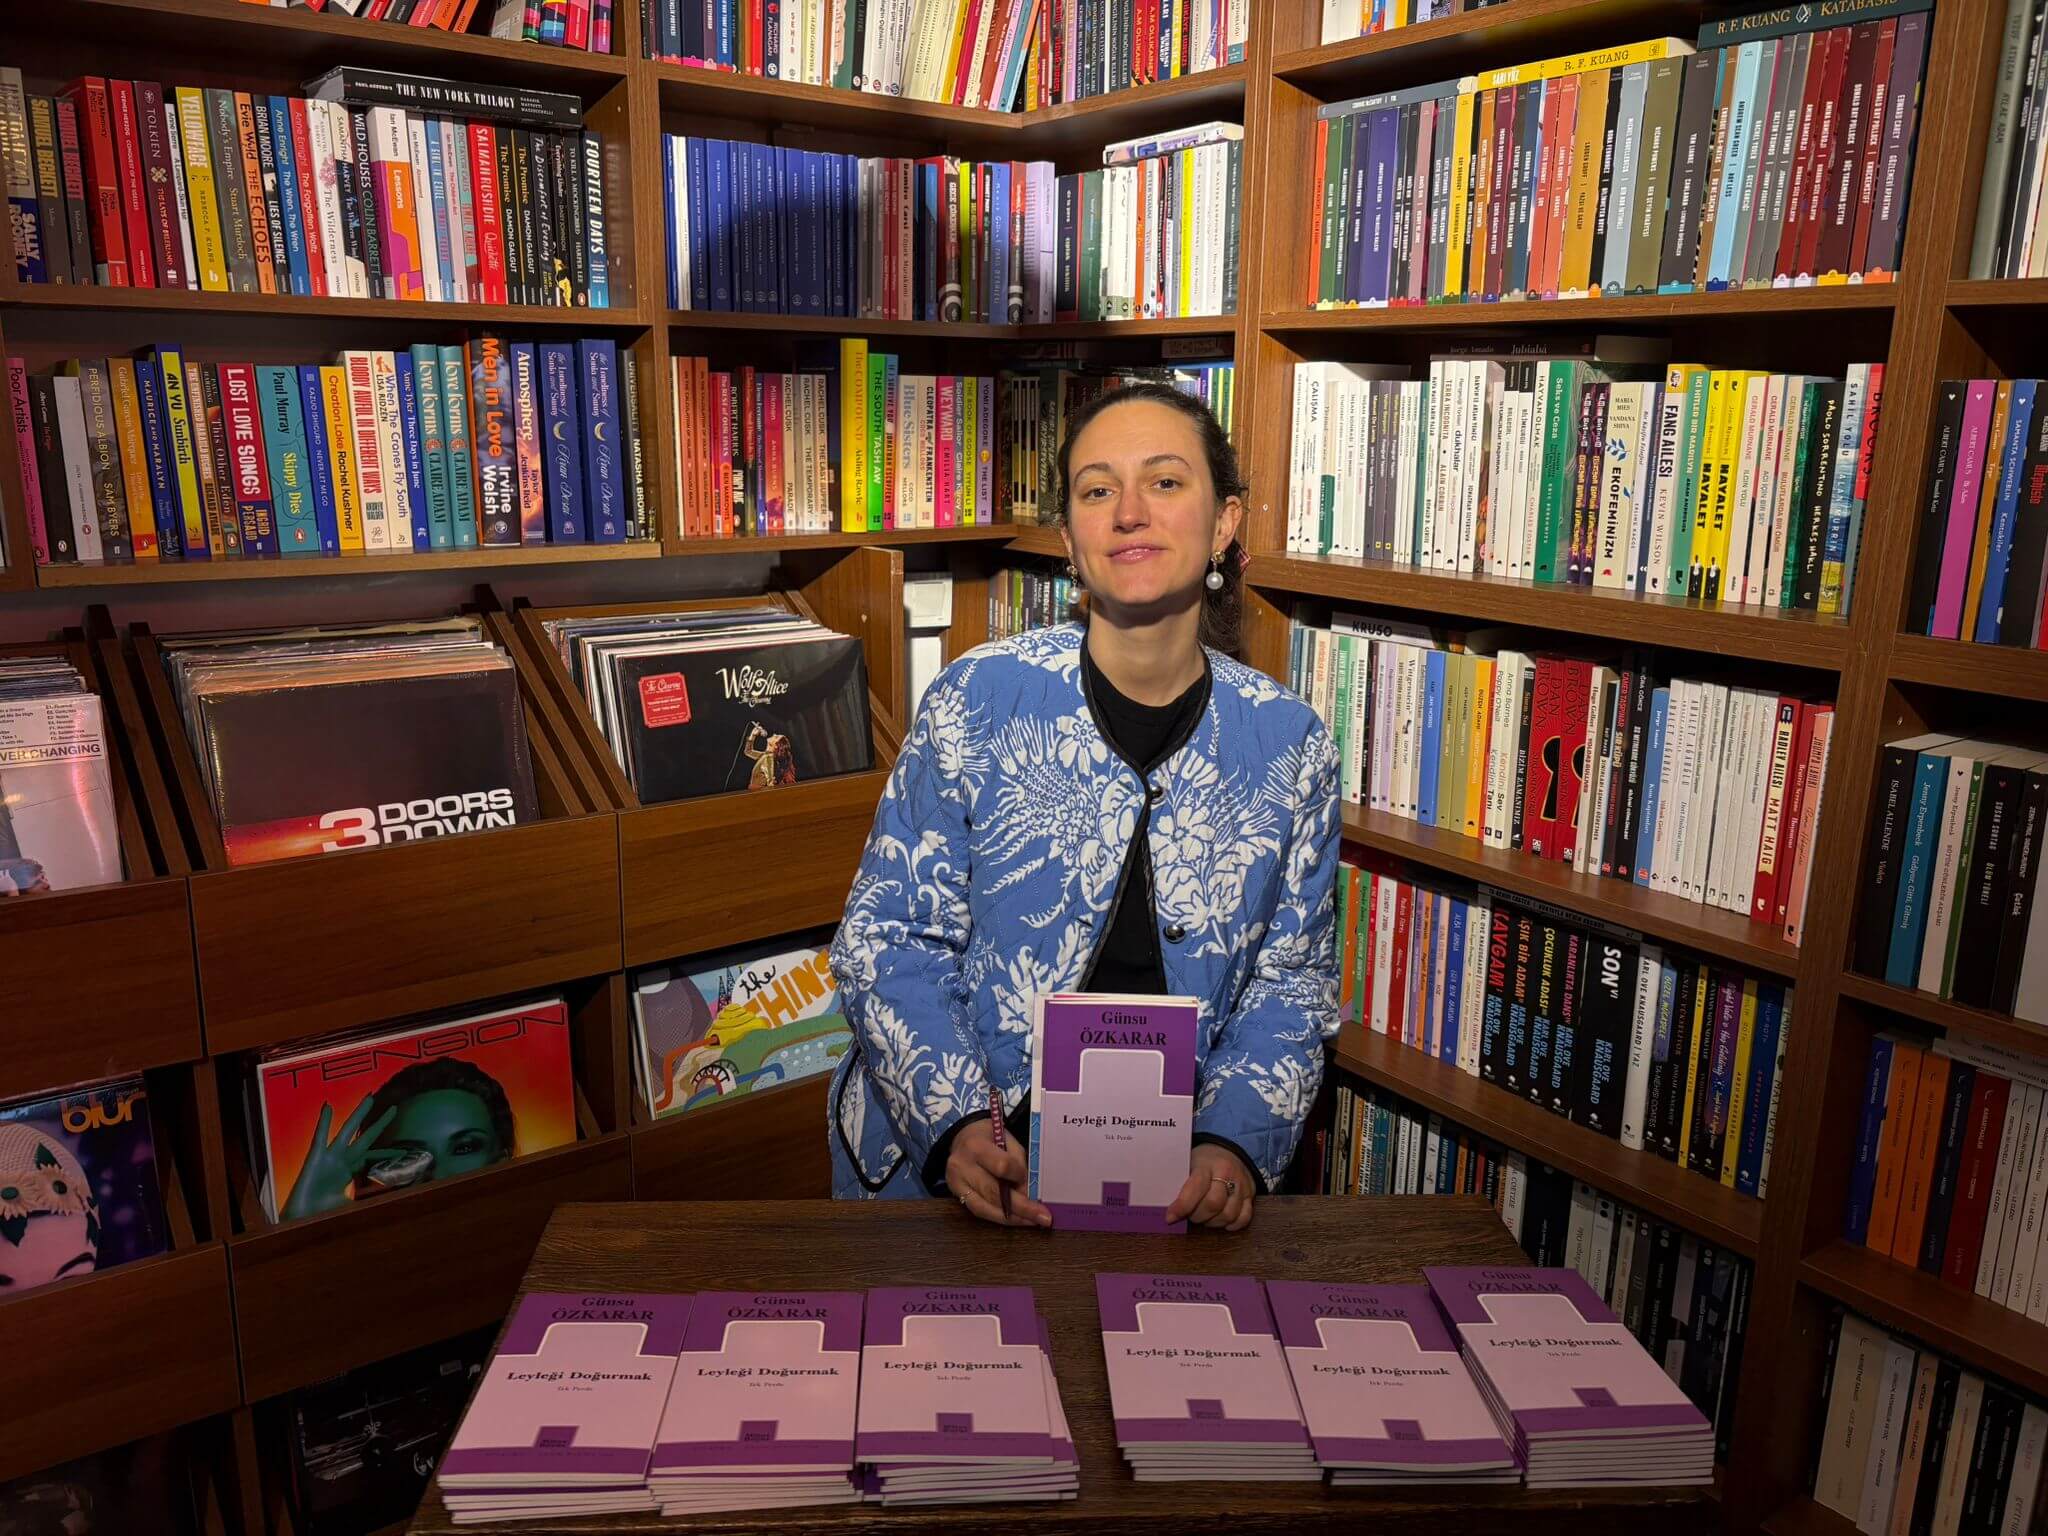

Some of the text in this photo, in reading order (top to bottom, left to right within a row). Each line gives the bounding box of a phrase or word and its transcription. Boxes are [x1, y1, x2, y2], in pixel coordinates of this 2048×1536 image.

[1717, 9, 1790, 34] R. F. KUANG
[1564, 50, 1629, 71] R. F. KUANG
[396, 83, 516, 109] THE NEW YORK TRILOGY
[145, 108, 161, 158] TOLKIEN
[181, 95, 208, 168] YELLOWFACE
[218, 100, 235, 180] Nobody's Empire
[390, 128, 399, 157] McEwan
[240, 103, 271, 264] Evie Wyld THE ECHOES
[255, 105, 286, 265] BRIAN MOORE LIES OF SILENCE
[353, 113, 382, 276] WILD HOUSES COLIN BARRETT
[393, 169, 404, 209] Lessons
[586, 140, 604, 254] FOURTEEN DAYS
[9, 204, 28, 267] ROONEY
[23, 213, 40, 260] SALLY
[229, 187, 247, 260] Stuart Murdoch
[301, 172, 317, 254] The Forgotten Waltz
[505, 208, 517, 273] DAMON GALGUT
[9, 367, 27, 434] Poor Artists
[87, 368, 110, 470] PERFIDIOUS ALBION
[165, 372, 192, 465] AN YU Sunbirth
[273, 372, 291, 435] Paul Murray
[481, 337, 504, 456] Men in Love
[517, 351, 534, 441] Atmosphere
[940, 386, 953, 440] WEYWARD
[1310, 380, 1320, 422] ÇALIŞMA
[227, 368, 261, 495] LOST LOVE SONGS
[350, 357, 381, 493] BLOODY AWFUL IN DIFFERENT WAYS
[386, 375, 408, 518] When The Cranes Fly South
[872, 371, 882, 484] THE SOUTH TASH AW
[903, 385, 915, 469] Blue Sisters
[328, 375, 353, 531] Creation Lake Rachel Kushner
[1453, 430, 1462, 473] dukhalar
[282, 452, 301, 514] Skippy Dies
[482, 465, 498, 515] Welsh
[497, 466, 512, 514] Irvine
[1654, 405, 1678, 565] FANG AİLESİ KEVIN WILSON
[1697, 463, 1712, 529] HAYALET
[1713, 464, 1730, 531] HAYALET
[1807, 399, 1837, 574] PAOLO SORRENTINO HERKES HAKLI
[104, 483, 120, 536] SAM BYERS
[242, 505, 256, 541] PERSAUD
[255, 509, 270, 536] INGRID
[1604, 467, 1621, 558] EKOFEMİNİZM
[1352, 620, 1393, 637] KRUSO
[715, 665, 788, 699] Wolf Alice
[1536, 661, 1547, 729] BROWN
[31, 744, 101, 758] CHANGING
[1775, 731, 1789, 762] RADLEY
[320, 788, 514, 852] 3 DOORS
[382, 809, 516, 844] DOWN
[1766, 798, 1780, 833] MATT
[1880, 780, 1899, 851] ISABEL ALLENDE
[1761, 836, 1775, 864] HAIG
[739, 964, 776, 999] the
[1539, 928, 1555, 1013] ÇOCUKLUK ADASI
[1601, 946, 1622, 999] SON VI
[1080, 1027, 1167, 1046] ÖZKARAR
[1102, 1011, 1148, 1025] Günsu
[268, 1005, 565, 1090] TENSION
[1591, 1039, 1604, 1104] KNAUSGAARD
[1602, 1042, 1613, 1082] KARL OVE
[61, 1090, 147, 1133] blur
[1062, 1115, 1177, 1129] Leyleği Doğurmak
[581, 1297, 635, 1308] Günsu
[753, 1296, 806, 1306] Günsu
[1132, 1288, 1228, 1302] ÖZKARAR
[1152, 1278, 1203, 1289] Günsu
[552, 1308, 654, 1320] ÖZKARAR
[728, 1306, 828, 1319] ÖZKARAR
[884, 1361, 1023, 1371] Leyleği Doğurmak
[1126, 1348, 1261, 1359] Leyleği Doğurmak
[1489, 1338, 1622, 1348] Leyleği Doğurmak
[507, 1371, 653, 1382] Leyleği Doğurmak
[697, 1367, 839, 1377] Leyleği Doğurmak
[1313, 1364, 1450, 1377] Leyleği Doğurmak
